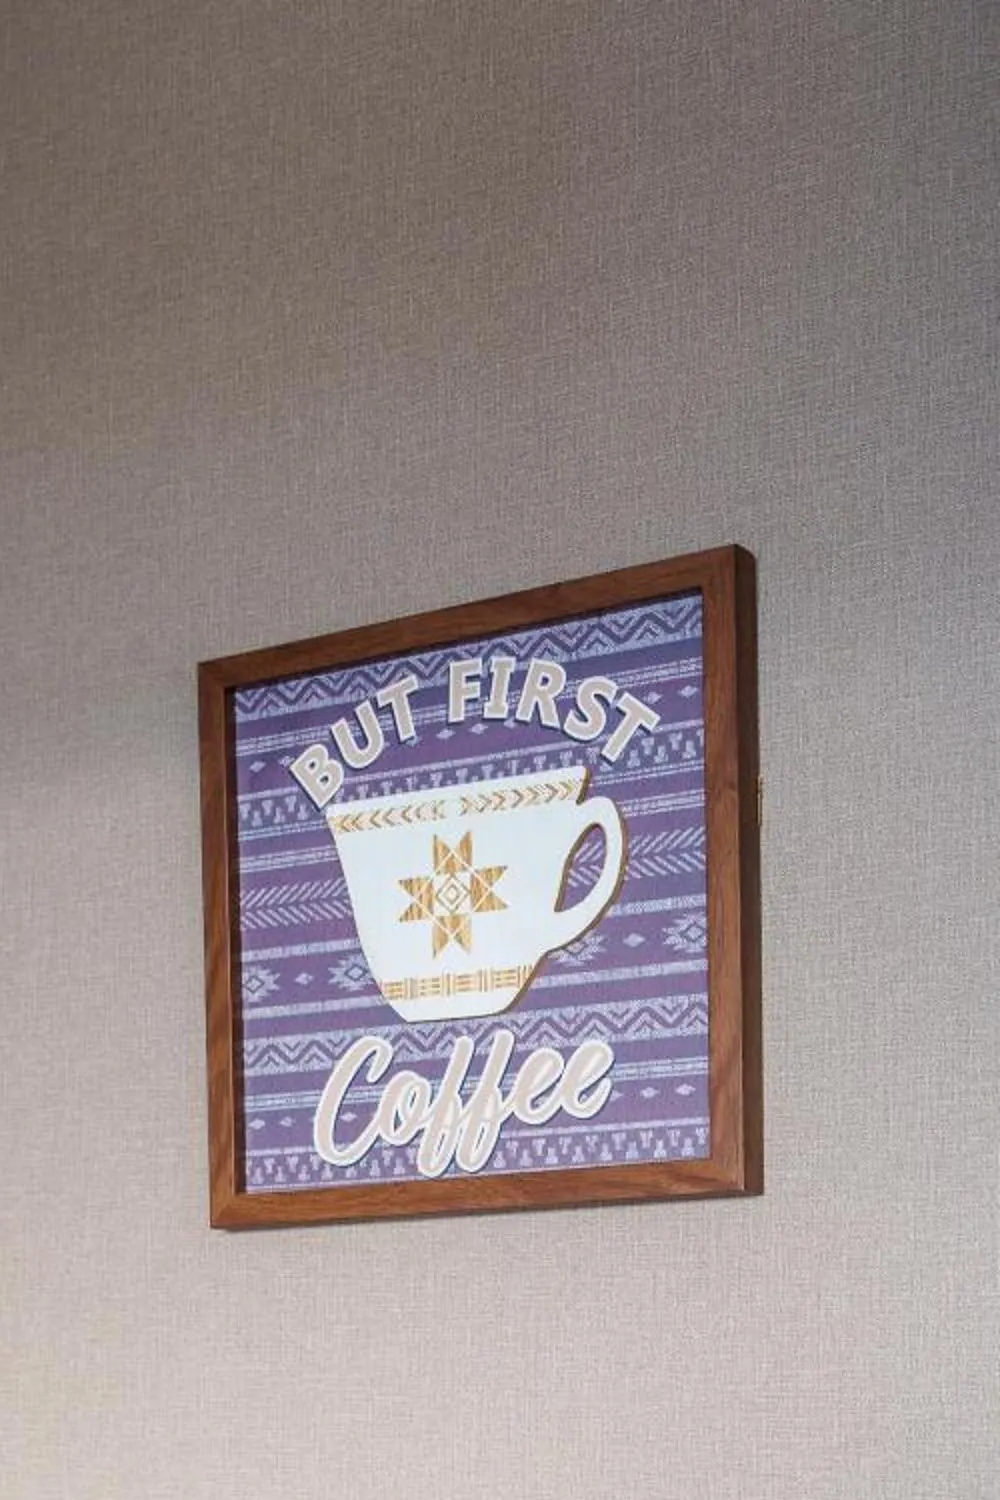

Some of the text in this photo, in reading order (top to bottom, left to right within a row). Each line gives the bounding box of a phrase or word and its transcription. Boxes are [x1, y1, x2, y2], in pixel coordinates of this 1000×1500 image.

[289, 655, 661, 810] BUT FIRST
[313, 1028, 616, 1178] Coffee
